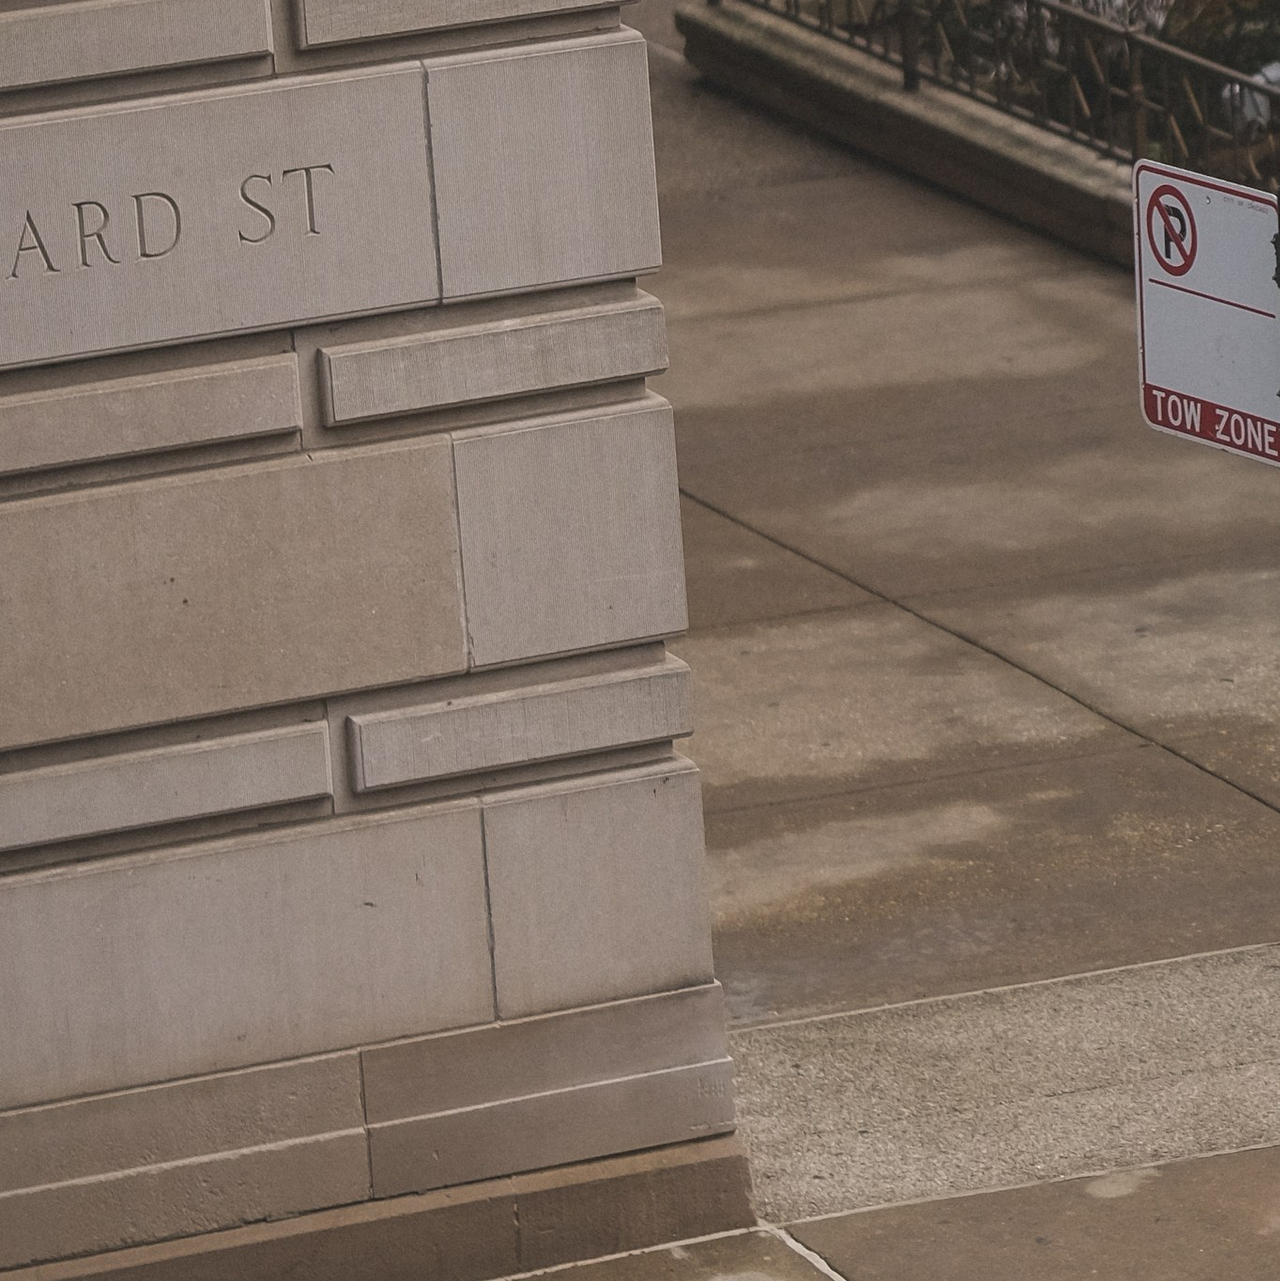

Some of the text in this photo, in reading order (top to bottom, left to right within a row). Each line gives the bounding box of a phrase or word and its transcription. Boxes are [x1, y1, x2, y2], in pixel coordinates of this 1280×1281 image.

[6, 164, 335, 279] ARD ST
[1164, 204, 1187, 259] P
[1152, 389, 1278, 456] TOW ZONE
